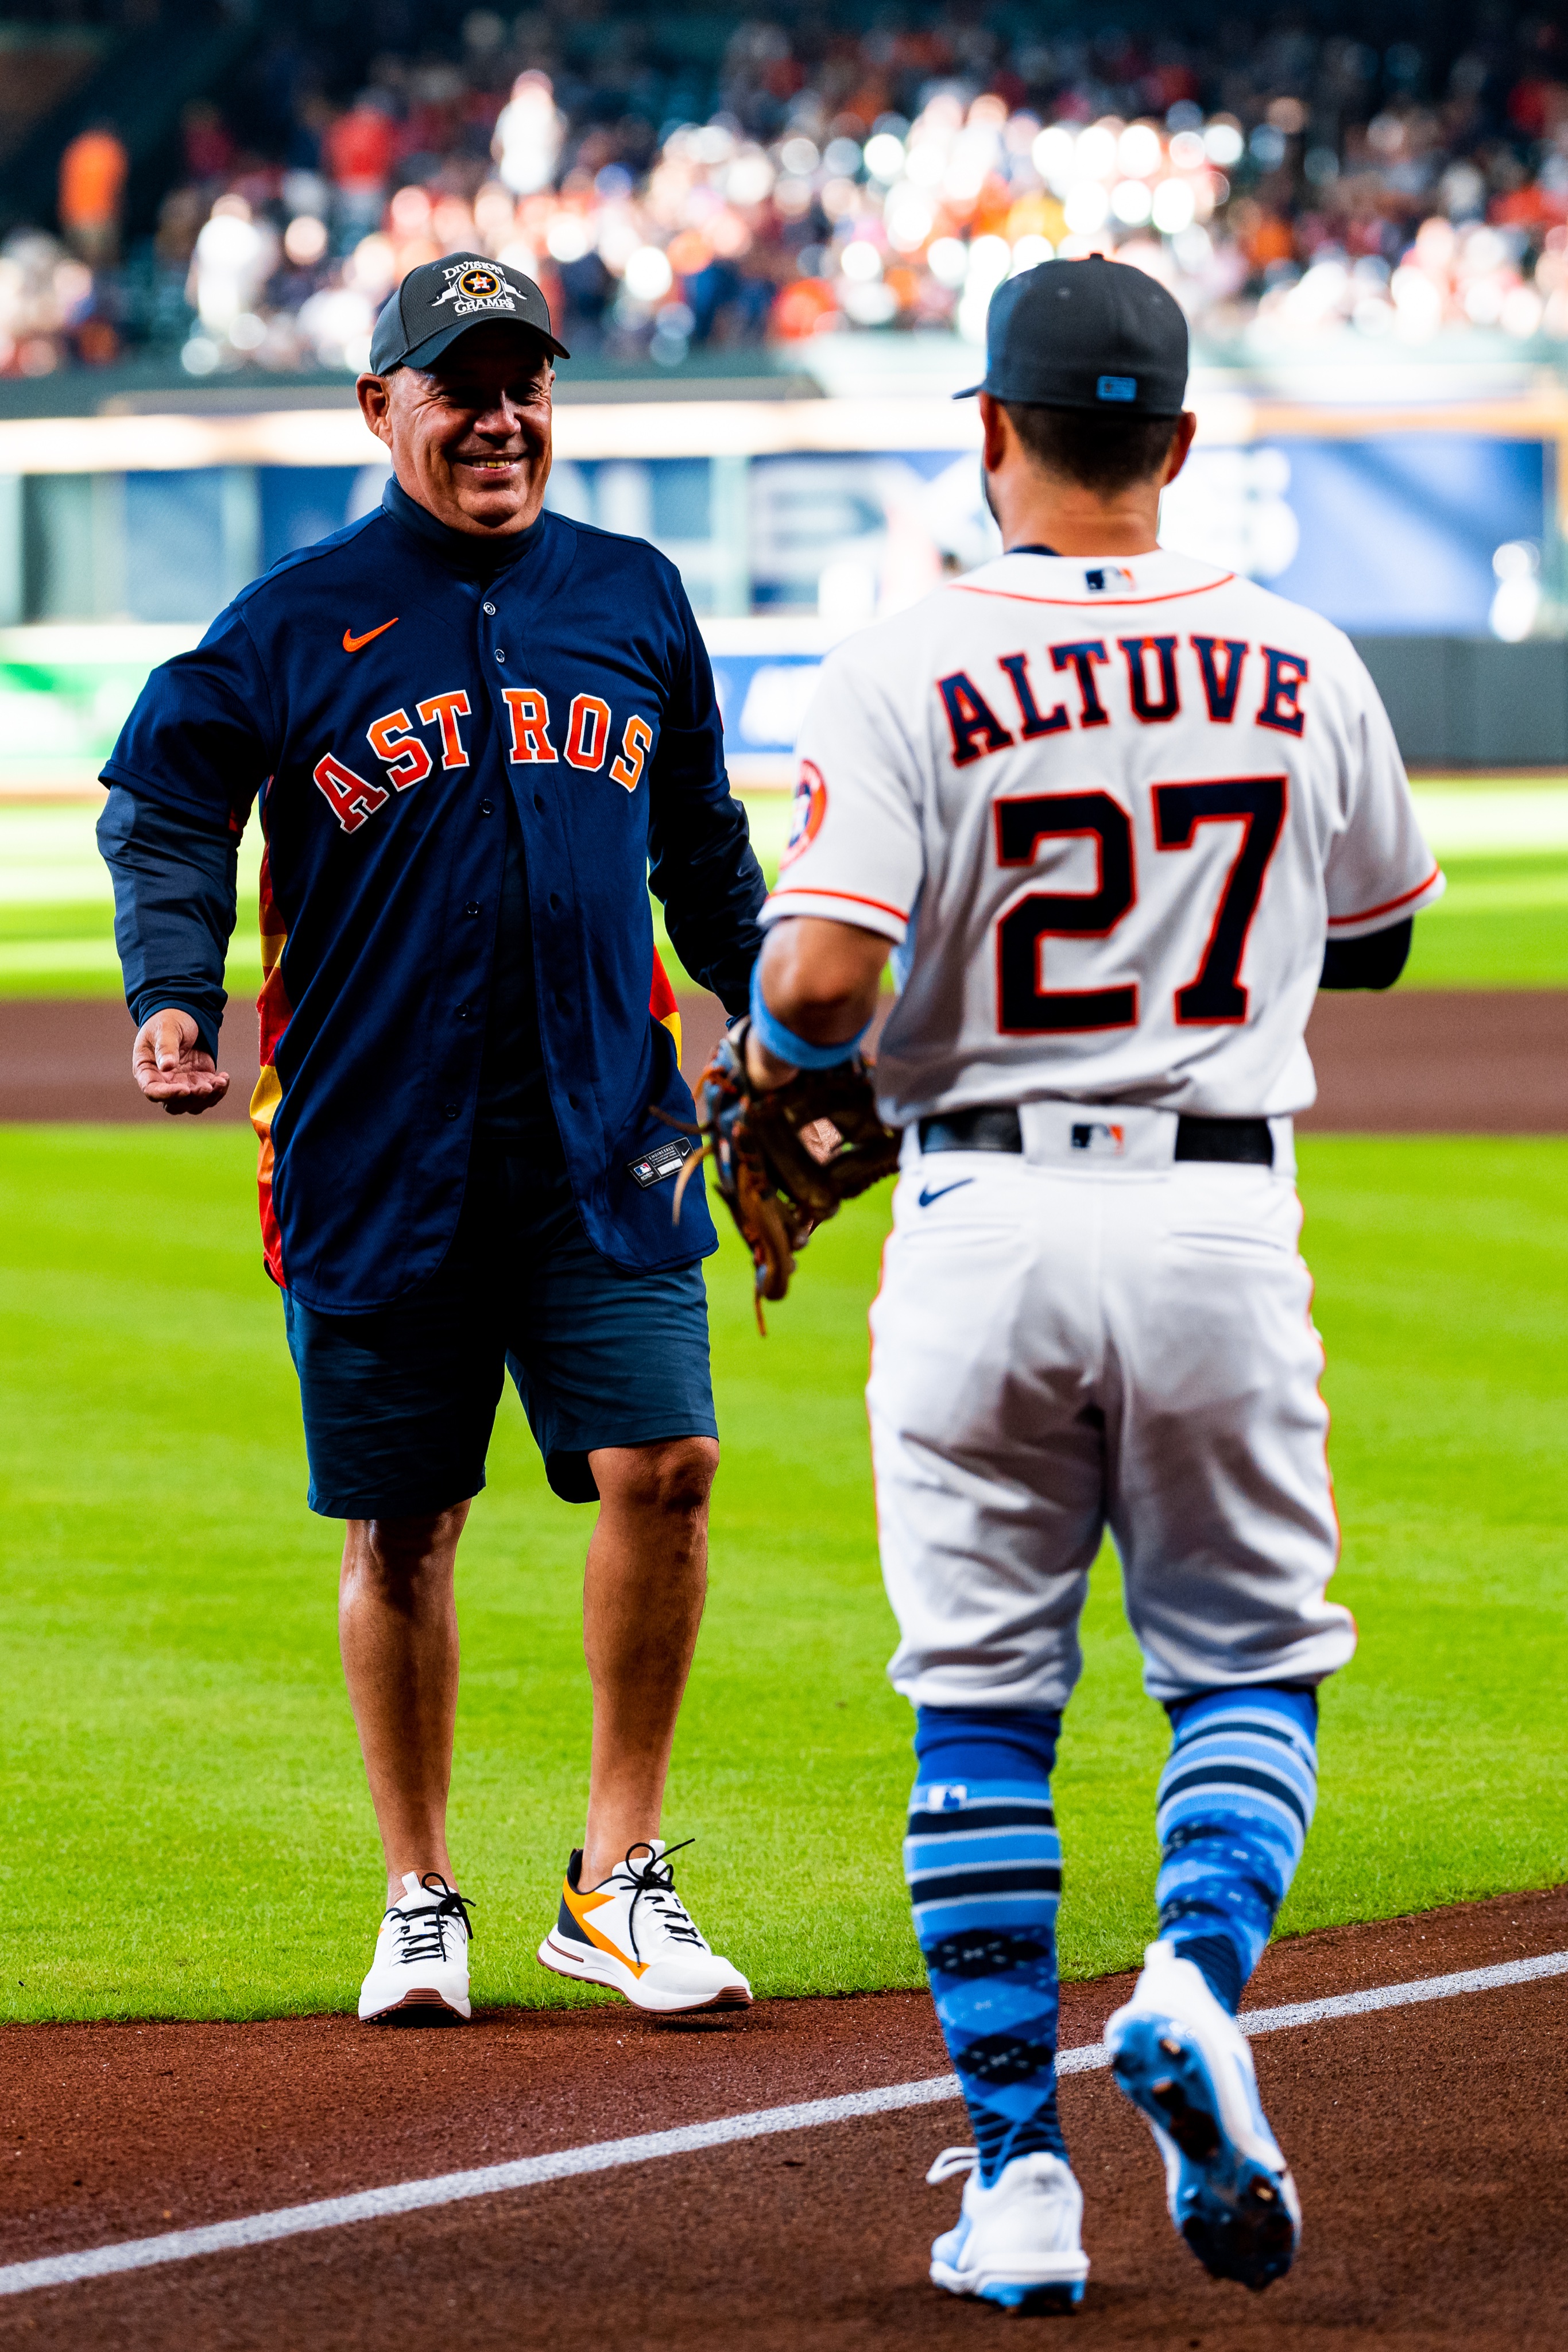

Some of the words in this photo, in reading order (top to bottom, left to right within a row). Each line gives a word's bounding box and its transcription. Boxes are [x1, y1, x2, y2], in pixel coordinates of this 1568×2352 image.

[442, 261, 504, 280] DIVISION
[454, 298, 515, 313] CHAMPS
[936, 633, 1310, 768] ALTUVE
[992, 775, 1290, 1035] 27
[649, 1146, 674, 1160] ENGINEERED
